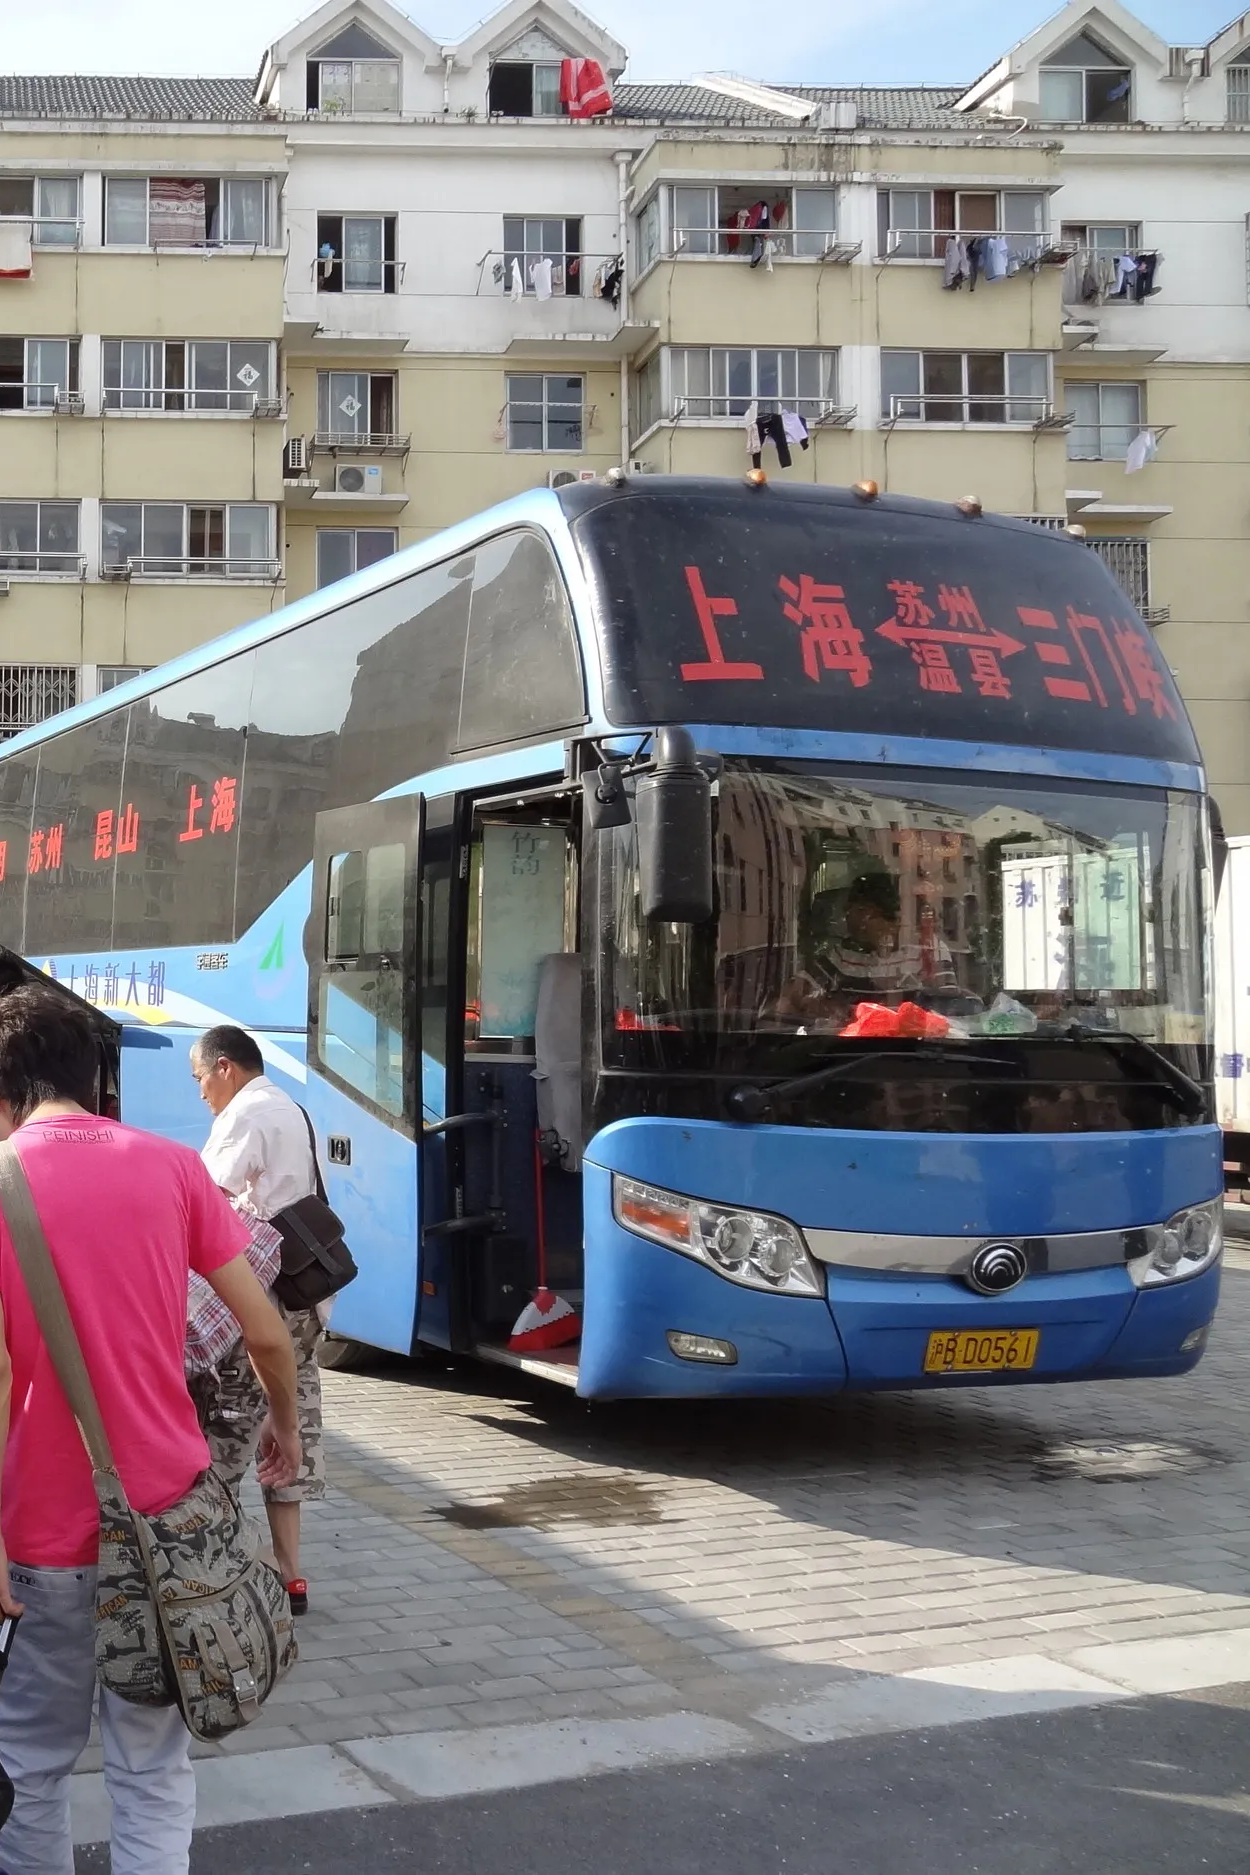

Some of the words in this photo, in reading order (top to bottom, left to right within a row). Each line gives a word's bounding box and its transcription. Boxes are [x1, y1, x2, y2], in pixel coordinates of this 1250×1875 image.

[680, 566, 873, 688] 上海
[1017, 604, 1178, 722] 三门峡
[887, 580, 988, 632] 苏州
[911, 641, 1013, 699] 温县
[29, 823, 63, 874] 苏州
[93, 803, 139, 860] 昆山
[179, 776, 237, 843] 上海
